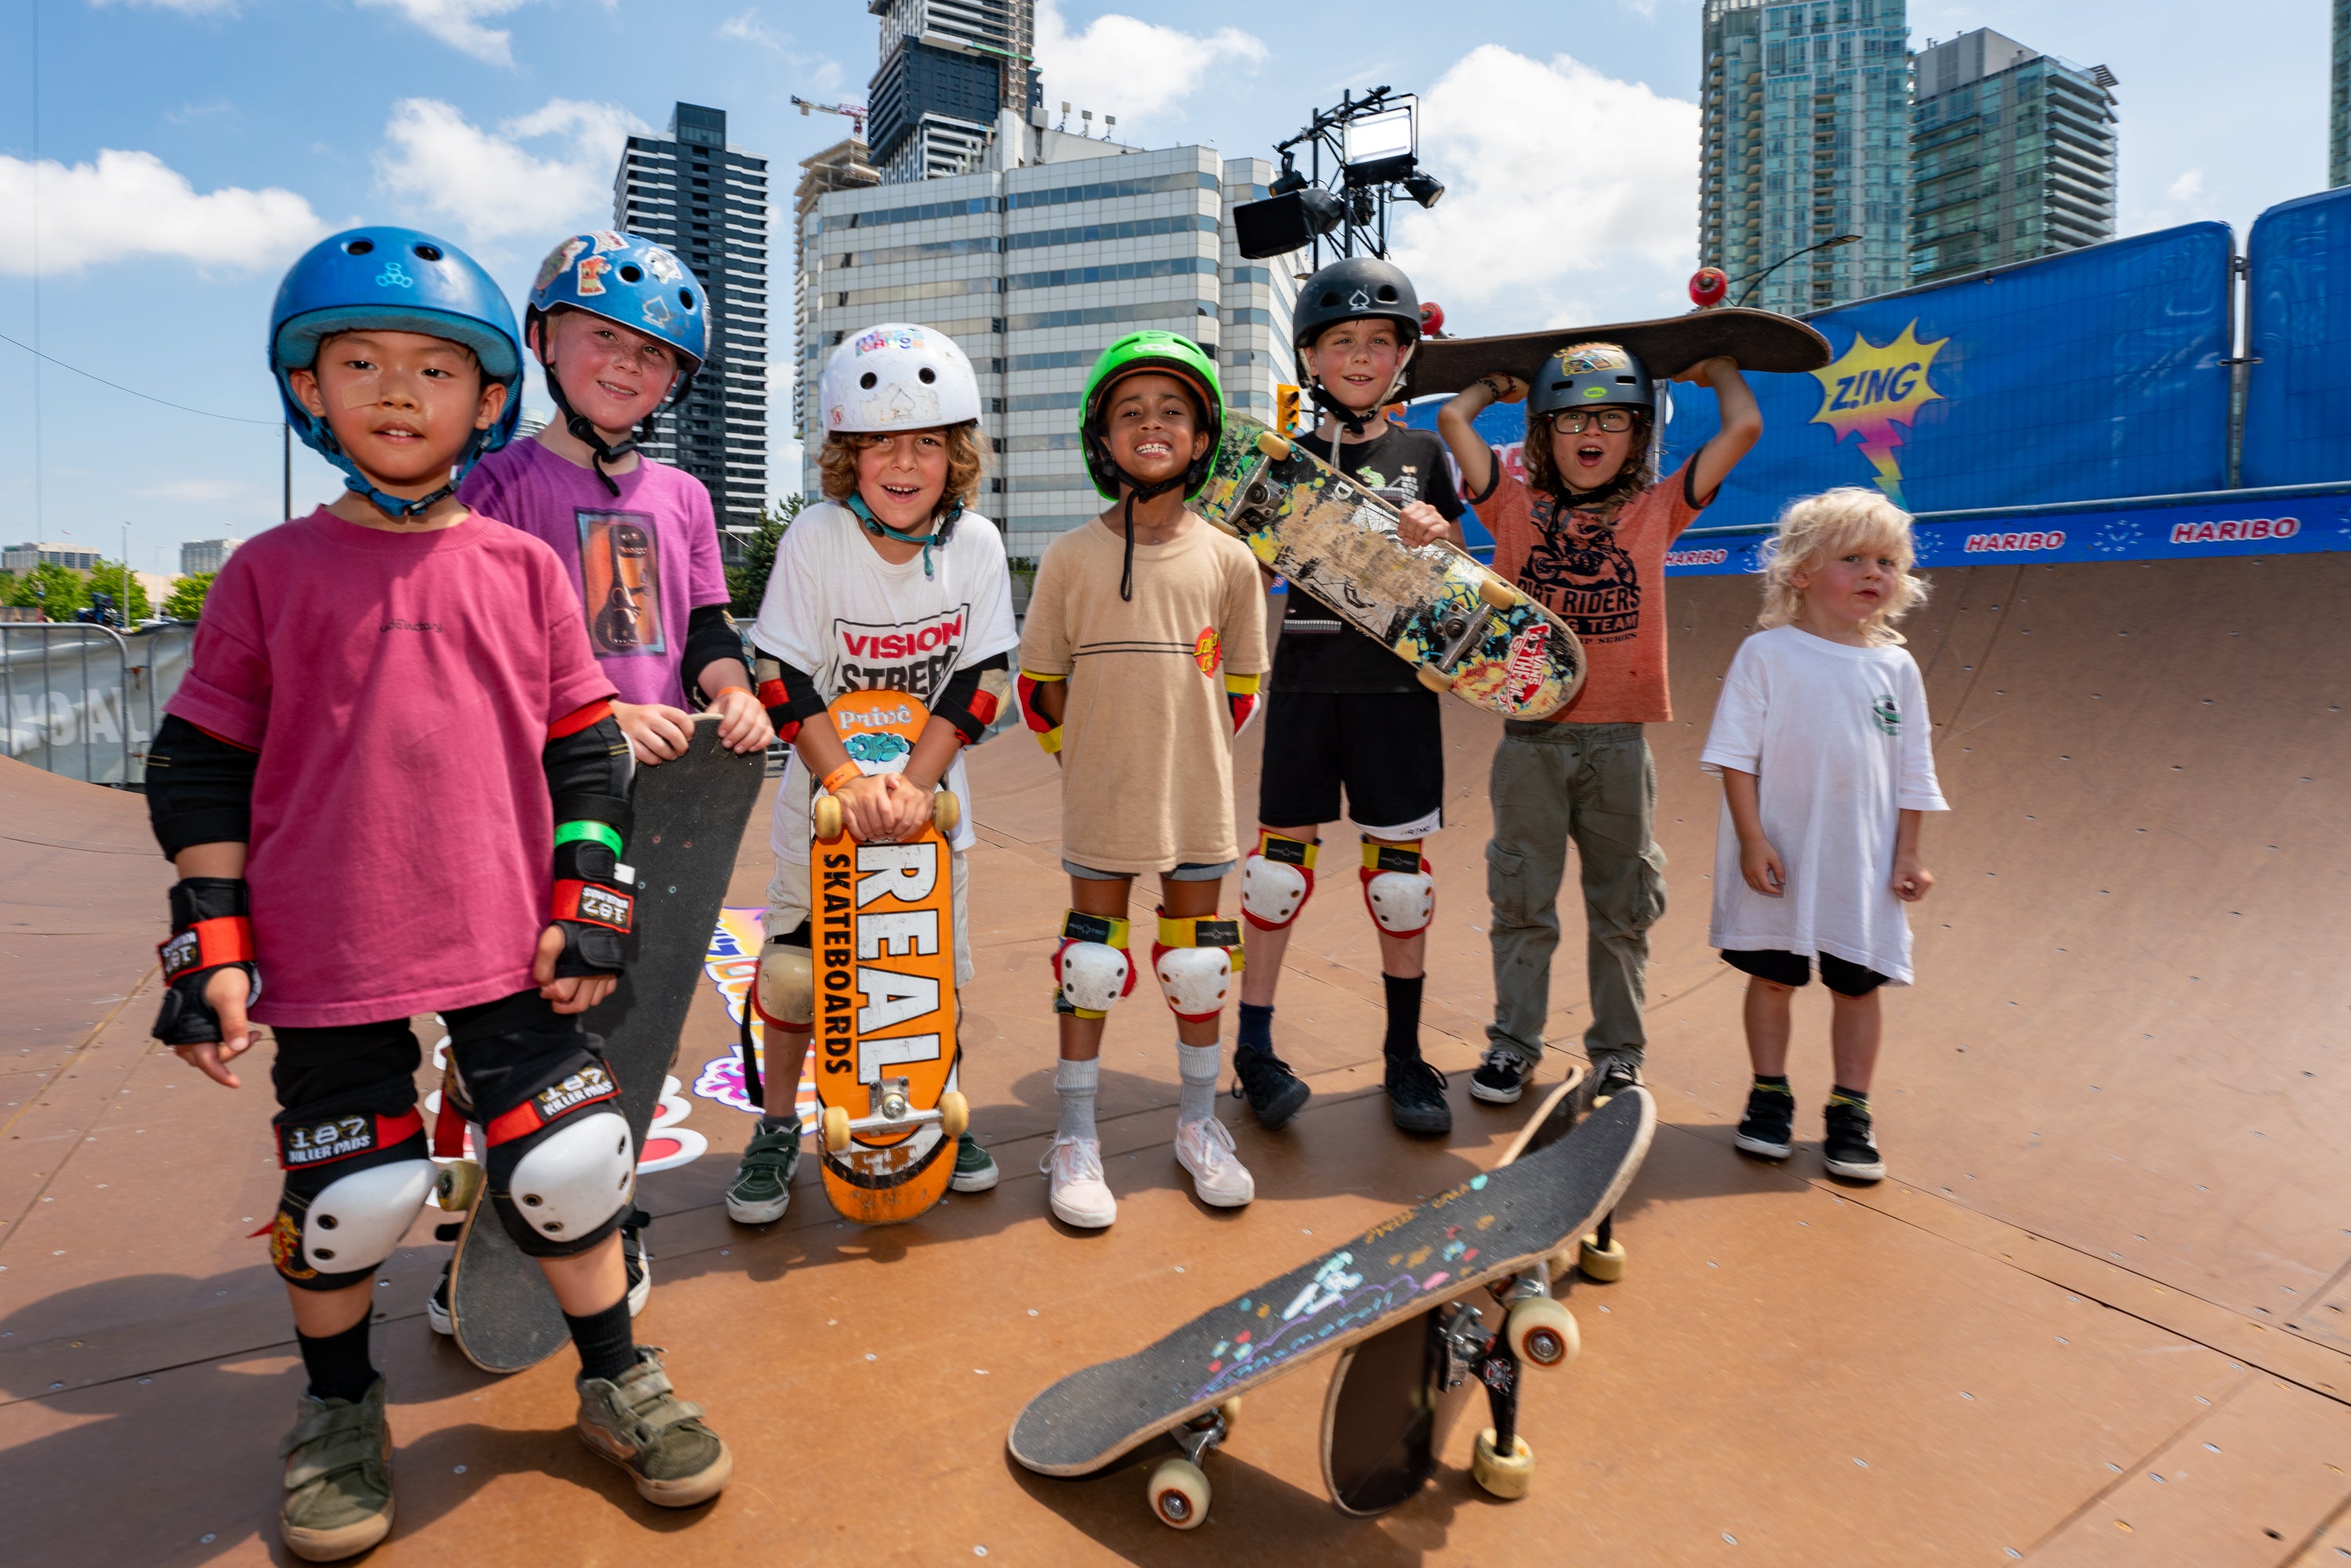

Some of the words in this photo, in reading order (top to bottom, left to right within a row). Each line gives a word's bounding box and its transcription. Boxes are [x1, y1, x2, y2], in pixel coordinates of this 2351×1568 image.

[1965, 531, 2066, 552] HARIBO
[2170, 516, 2301, 544] HARIBO
[1665, 549, 1728, 566] HARIBO
[1562, 586, 1641, 614] RIDERS
[842, 614, 962, 659] VISION
[1588, 615, 1638, 633] TEAM
[1598, 632, 1636, 644] SERIES
[1528, 654, 1547, 684] VANS
[582, 899, 625, 922] 187
[824, 854, 852, 1074] SKATEBOARDS
[856, 842, 940, 1085] REAL
[545, 1068, 602, 1102] 187
[543, 1089, 586, 1116] KILLER
[294, 1117, 365, 1149] 187
[288, 1146, 332, 1163] KILLER
[333, 1135, 371, 1155] PADS
